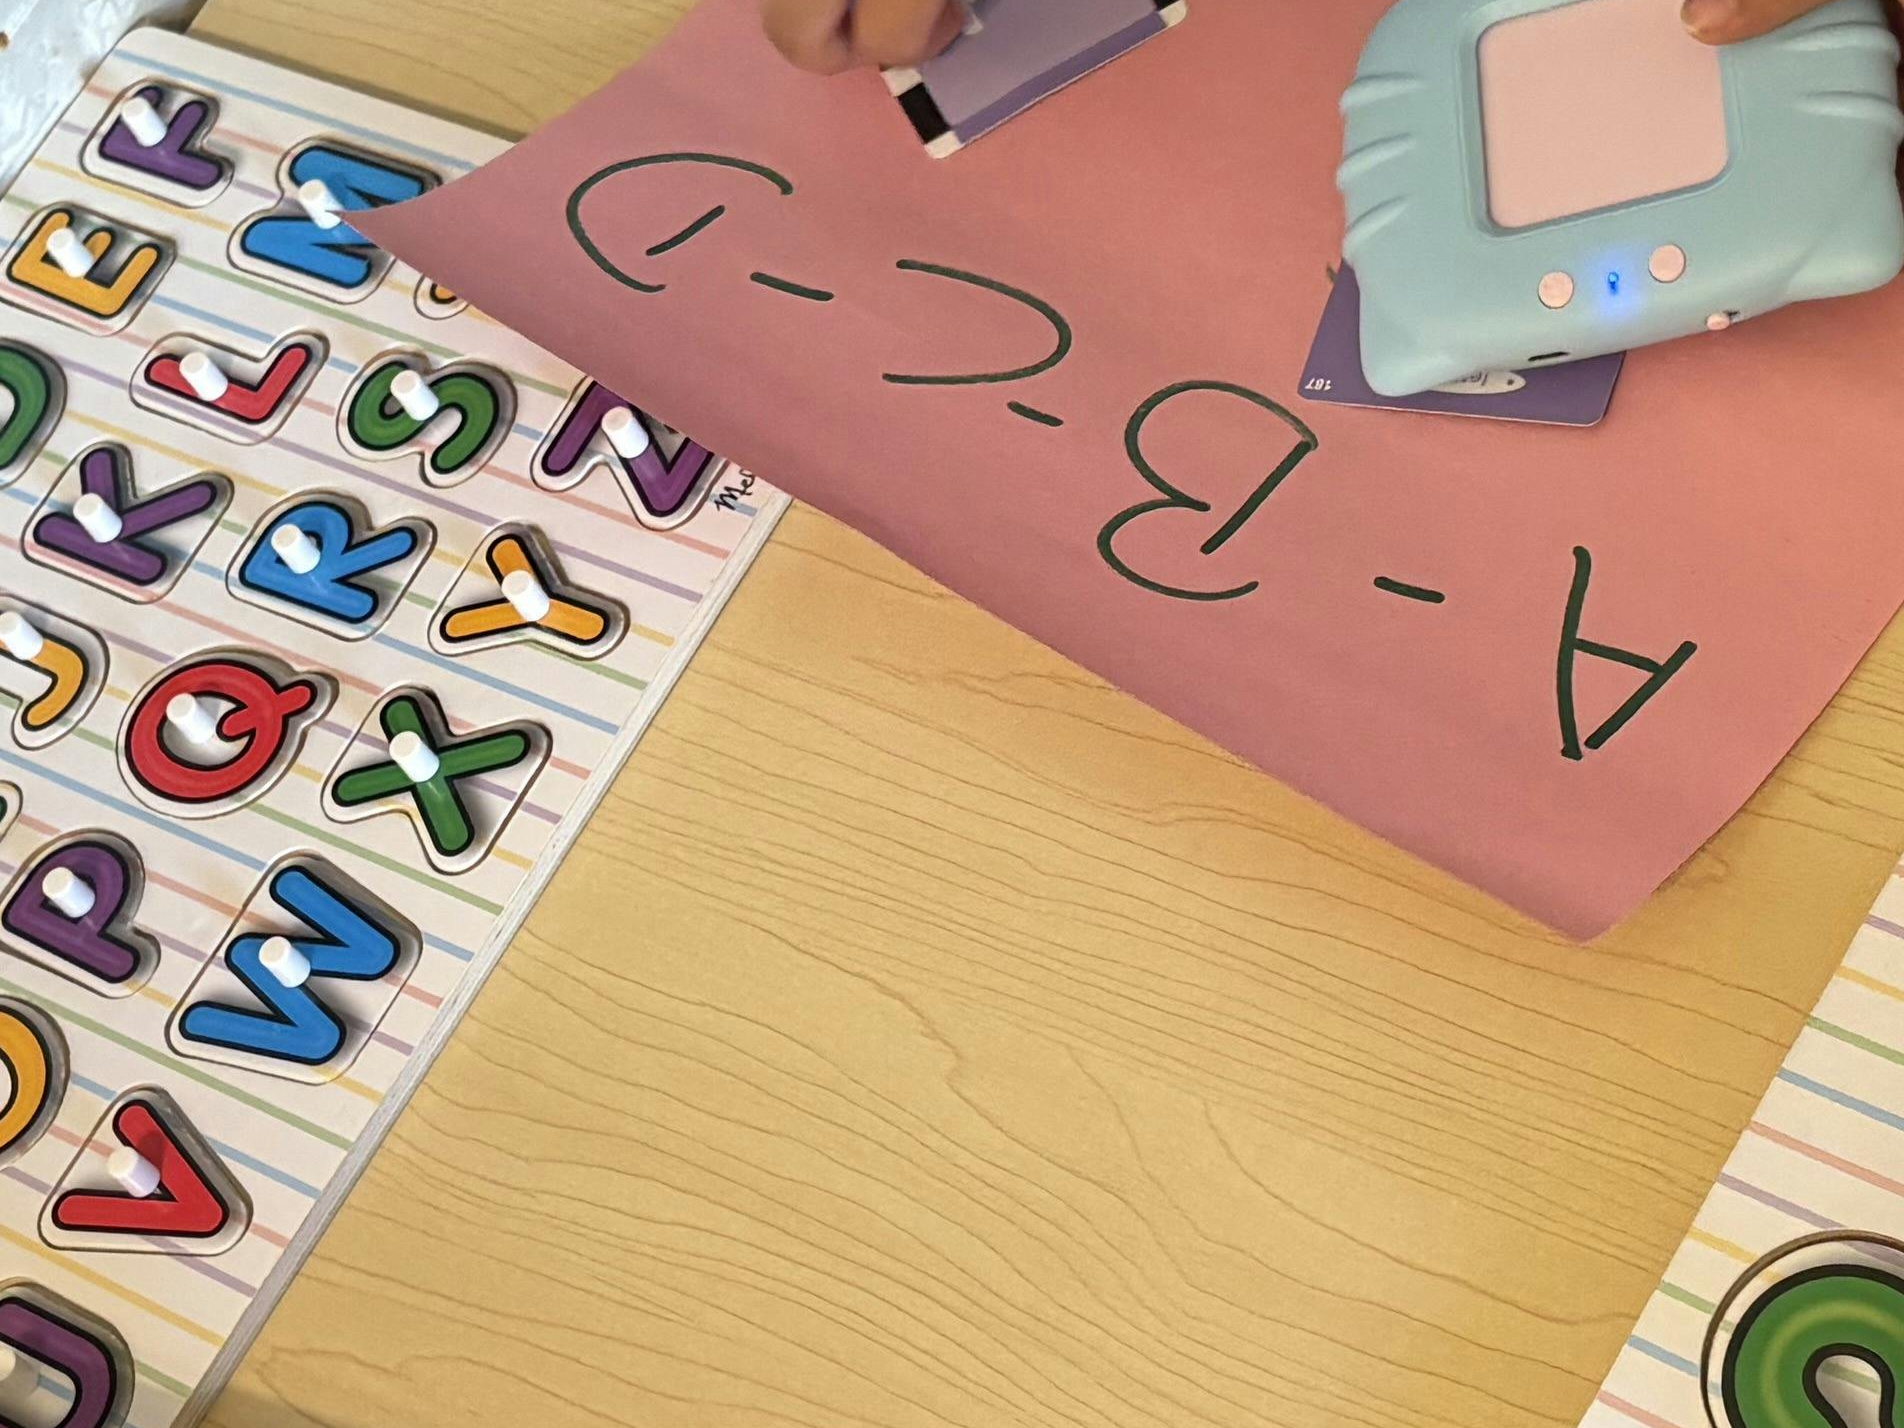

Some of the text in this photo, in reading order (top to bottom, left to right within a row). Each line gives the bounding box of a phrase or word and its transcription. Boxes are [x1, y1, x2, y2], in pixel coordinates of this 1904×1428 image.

[6, 206, 163, 320] E
[33, 447, 217, 585] K
[143, 342, 311, 421] L
[1, 841, 142, 983] P
[124, 659, 320, 805] Q
[238, 500, 418, 625] R
[346, 359, 498, 476] S
[51, 1098, 231, 1240] V
[179, 864, 400, 1065] W
[330, 689, 533, 857] X
[438, 531, 611, 645] Y
